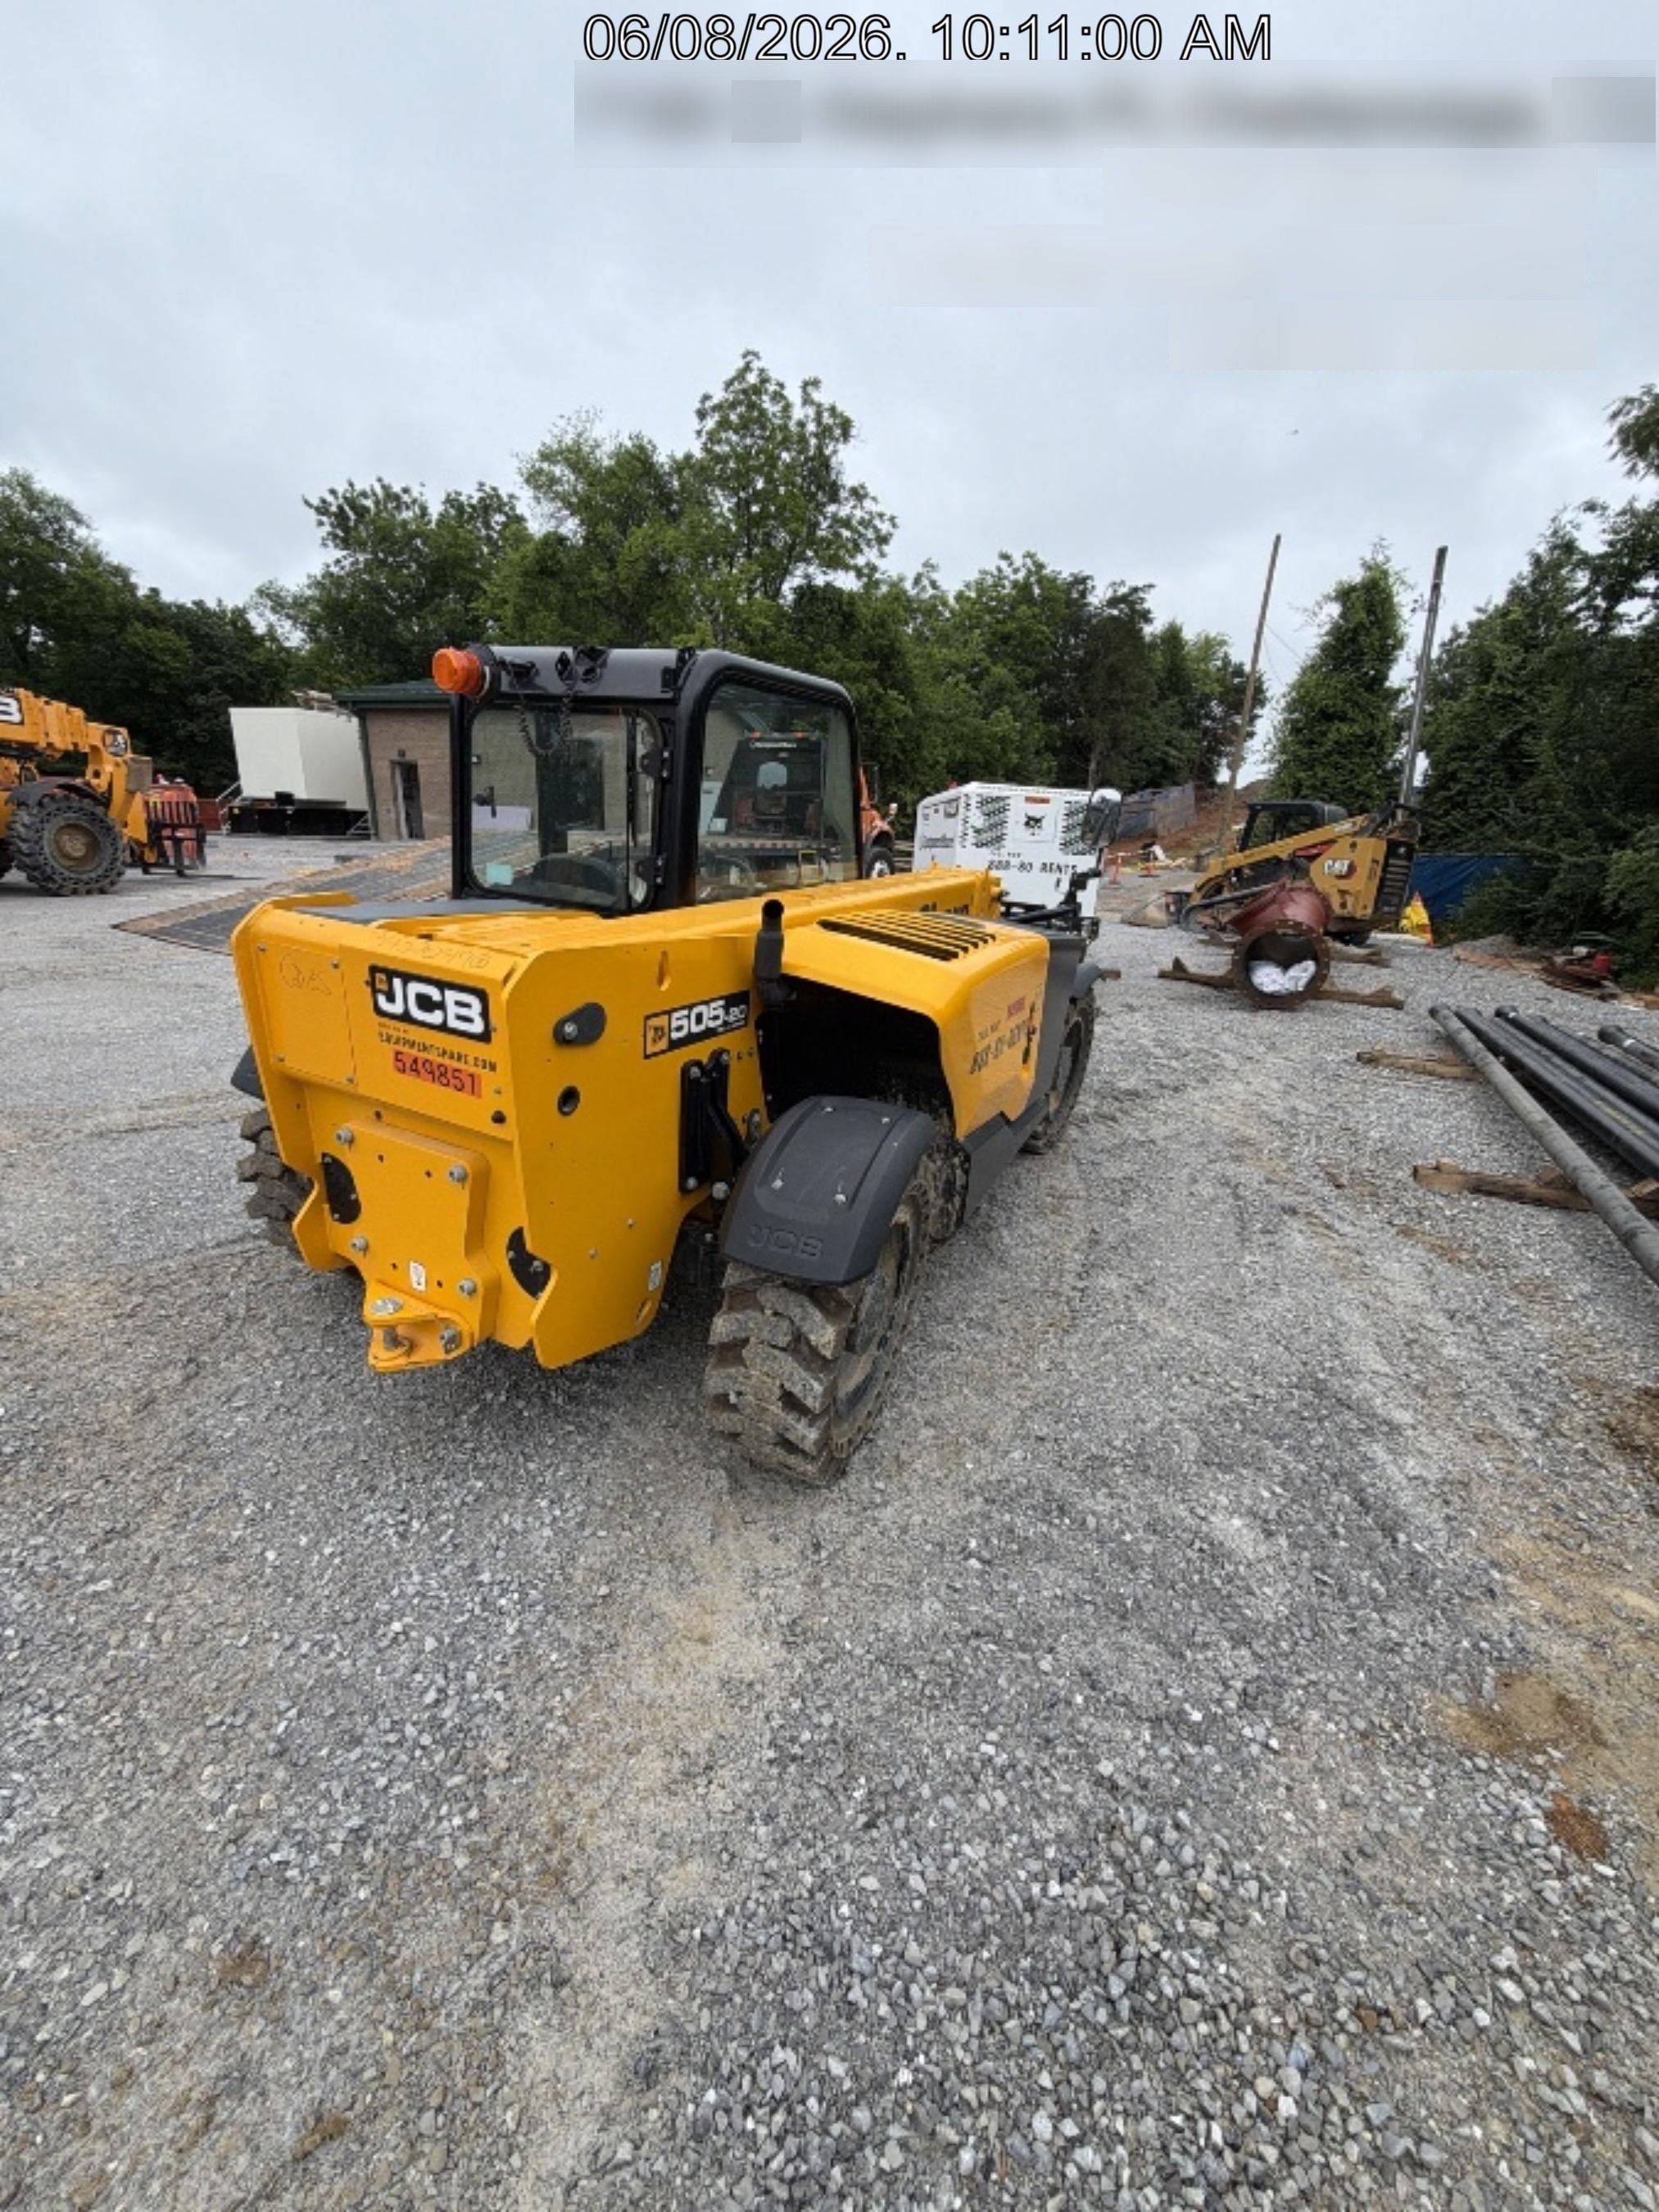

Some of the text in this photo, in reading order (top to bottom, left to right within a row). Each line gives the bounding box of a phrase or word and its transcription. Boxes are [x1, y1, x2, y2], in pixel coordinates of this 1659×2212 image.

[377, 977, 486, 1035] JCB
[394, 1050, 475, 1096] 549851
[747, 1223, 824, 1258] JCB
